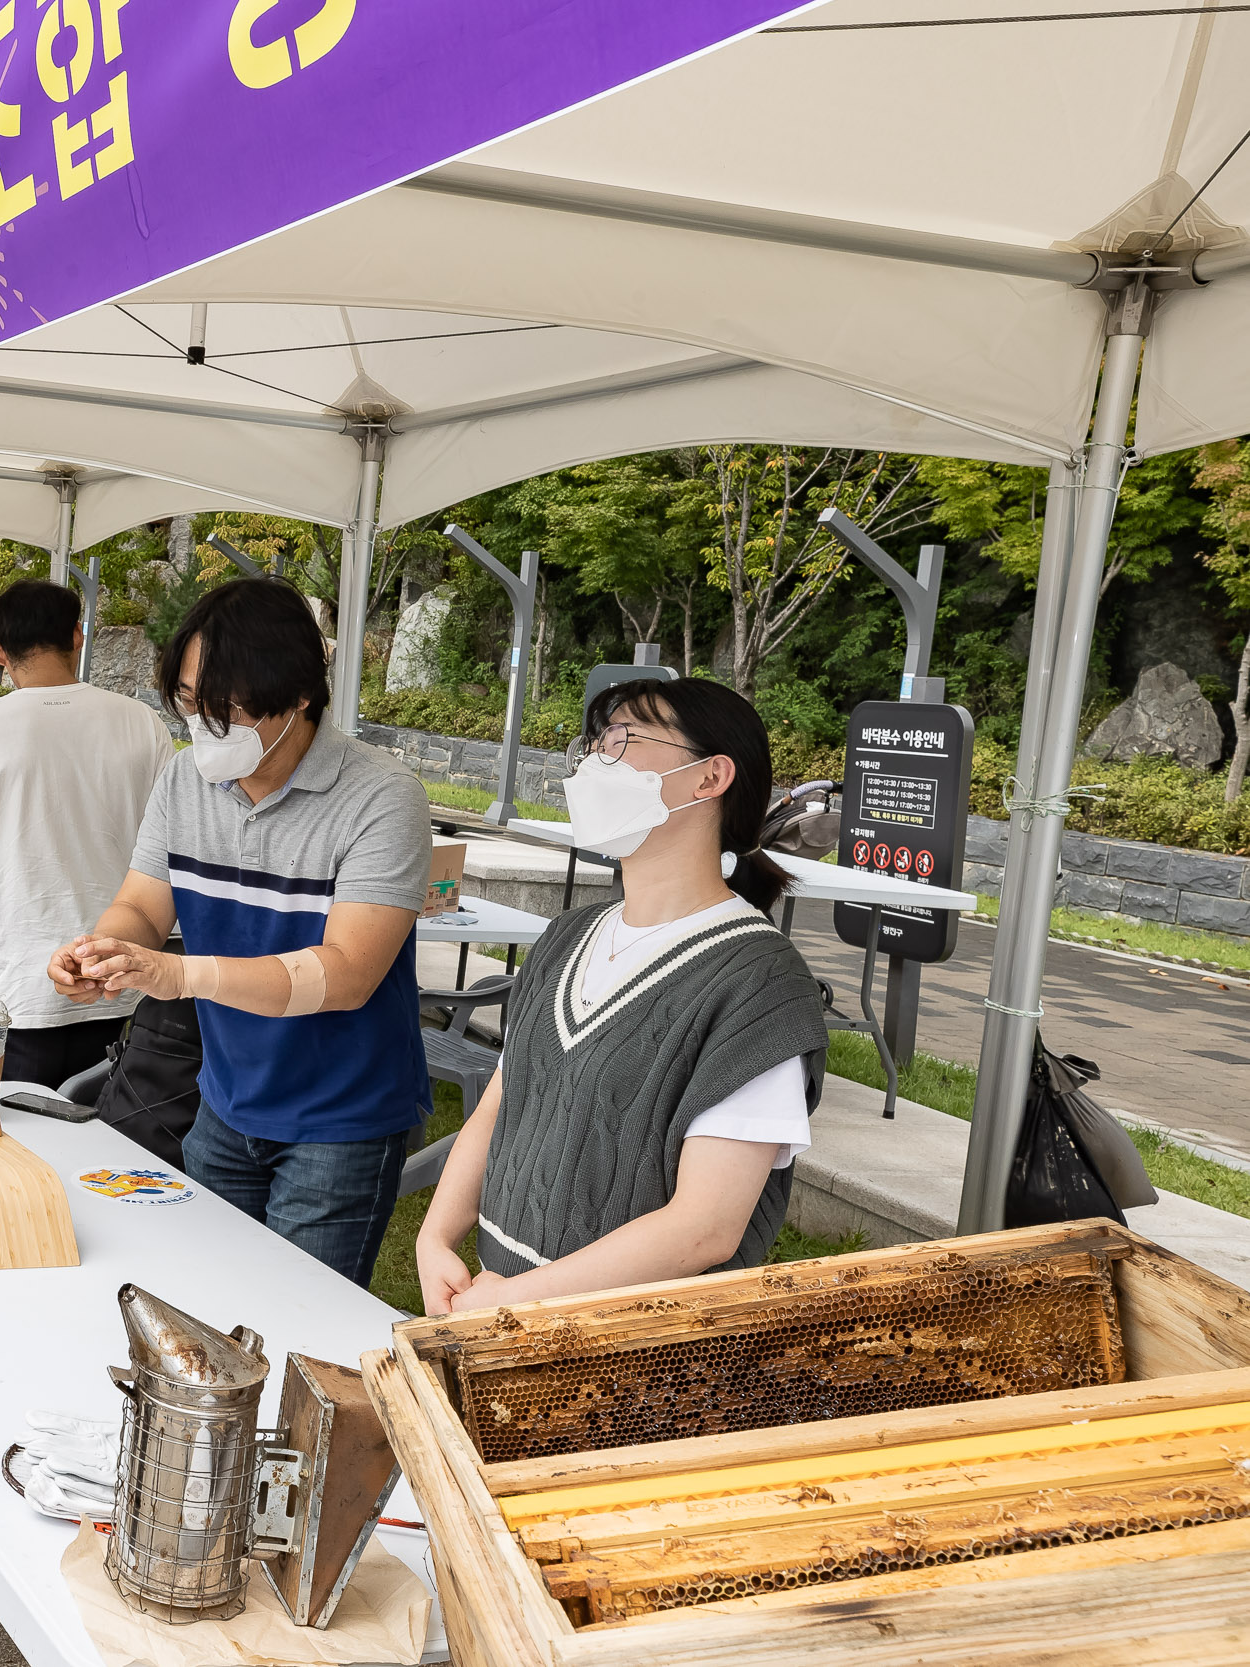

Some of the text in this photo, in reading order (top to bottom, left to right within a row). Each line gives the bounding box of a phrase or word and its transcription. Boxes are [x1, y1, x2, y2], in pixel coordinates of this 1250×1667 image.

[862, 727, 945, 749] 바닥분수 이용안내
[882, 925, 903, 937] 광진구
